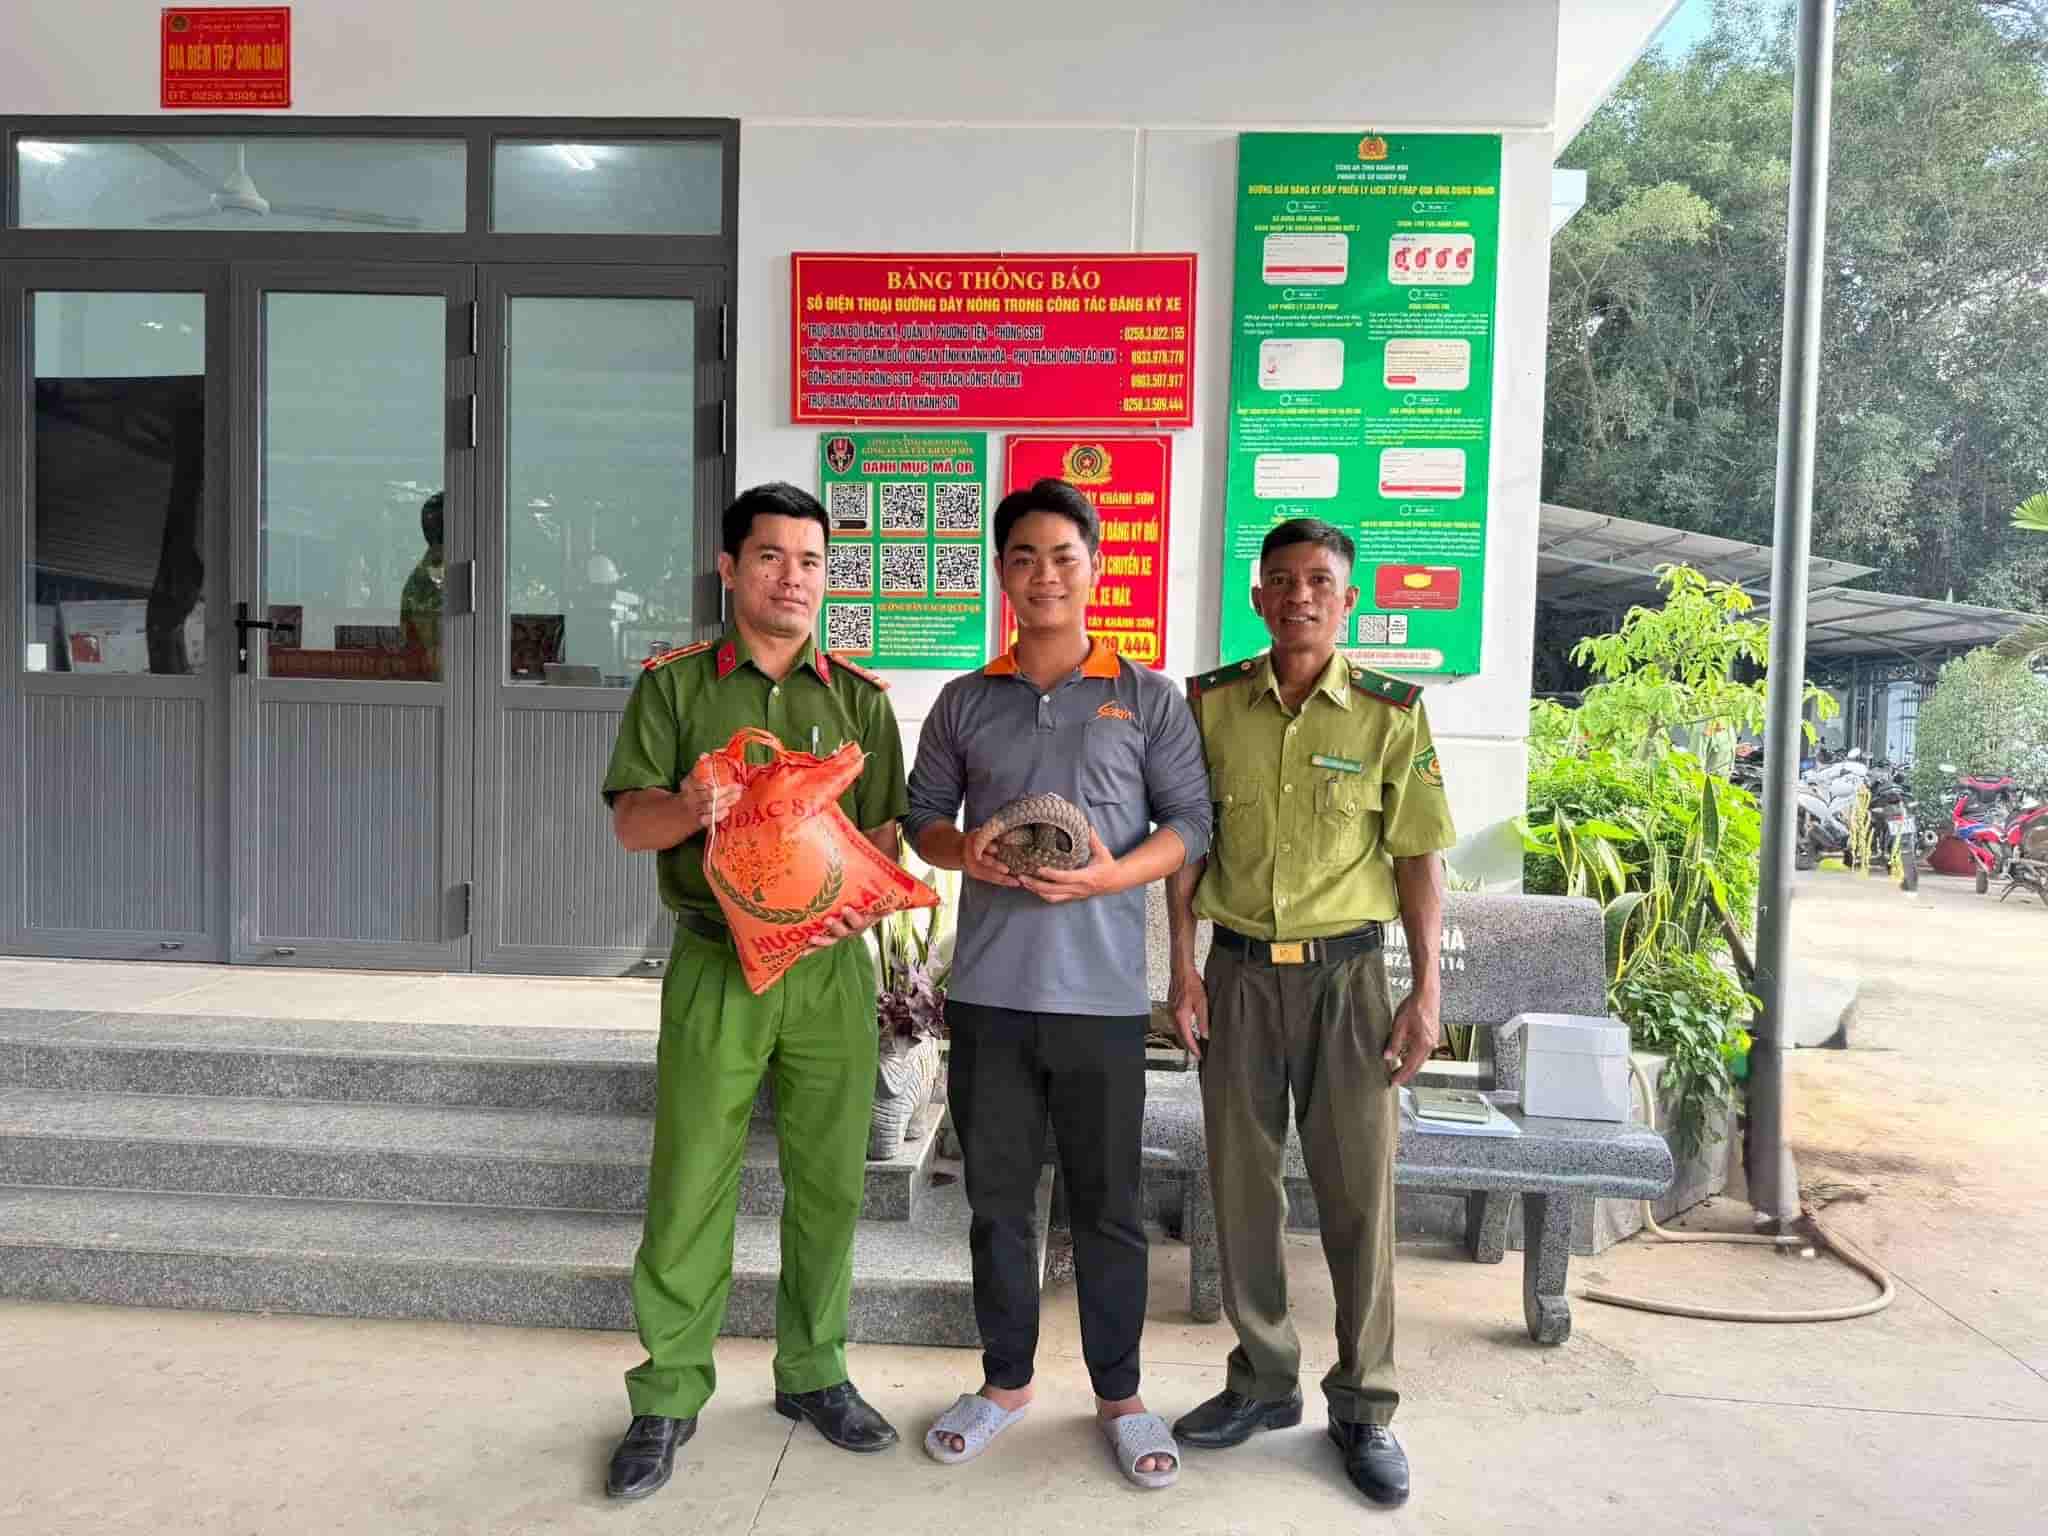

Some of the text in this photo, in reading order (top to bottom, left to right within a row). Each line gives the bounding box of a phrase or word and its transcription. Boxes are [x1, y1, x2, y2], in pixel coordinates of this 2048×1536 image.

[887, 266, 1100, 290] BẢNG THÔNG BÁO
[807, 291, 823, 311] SỐ
[826, 295, 854, 314] ĐIỆN
[858, 297, 892, 314] THOẠI
[939, 296, 963, 312] DÂY
[1004, 298, 1043, 312] TRONG
[1047, 296, 1080, 312] CÔNG
[1084, 296, 1106, 312] TÁC
[1109, 296, 1143, 312] ĐĂNG
[1147, 296, 1162, 312] KÝ
[1165, 298, 1182, 312] XE
[863, 460, 897, 473] DANH
[900, 460, 928, 477] MỤC
[1135, 491, 1154, 504] SƠN
[1141, 556, 1152, 576] XE
[1100, 587, 1112, 607] XE
